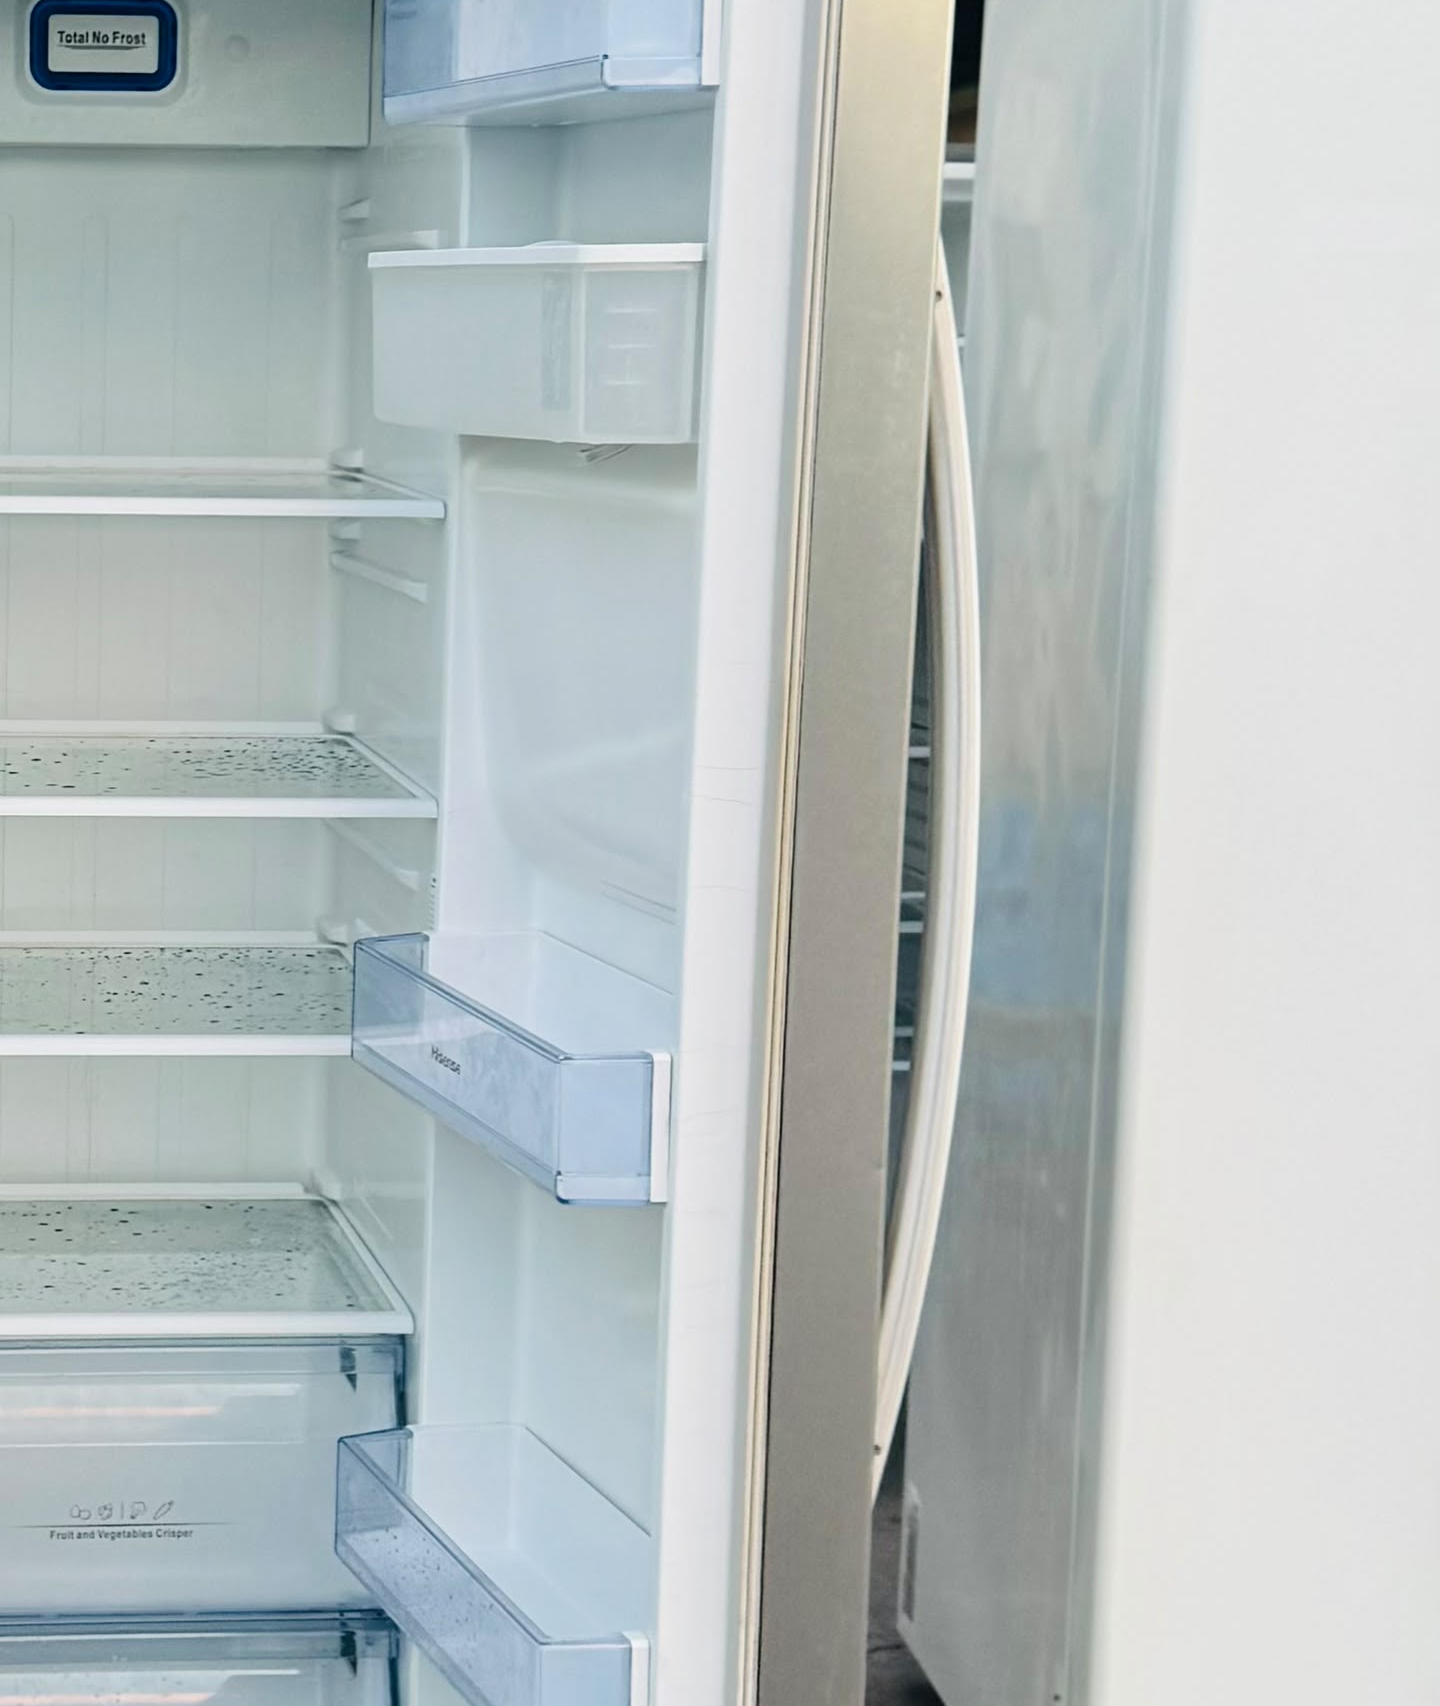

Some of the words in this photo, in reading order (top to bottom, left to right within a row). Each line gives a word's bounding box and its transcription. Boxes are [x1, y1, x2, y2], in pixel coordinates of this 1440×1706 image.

[57, 31, 89, 43] Total
[92, 31, 110, 44] No
[112, 31, 147, 45] Frost
[50, 1529, 75, 1540] Fruit
[76, 1529, 96, 1539] and
[97, 1528, 154, 1541] Vegetables
[155, 1527, 194, 1539] Crisper
